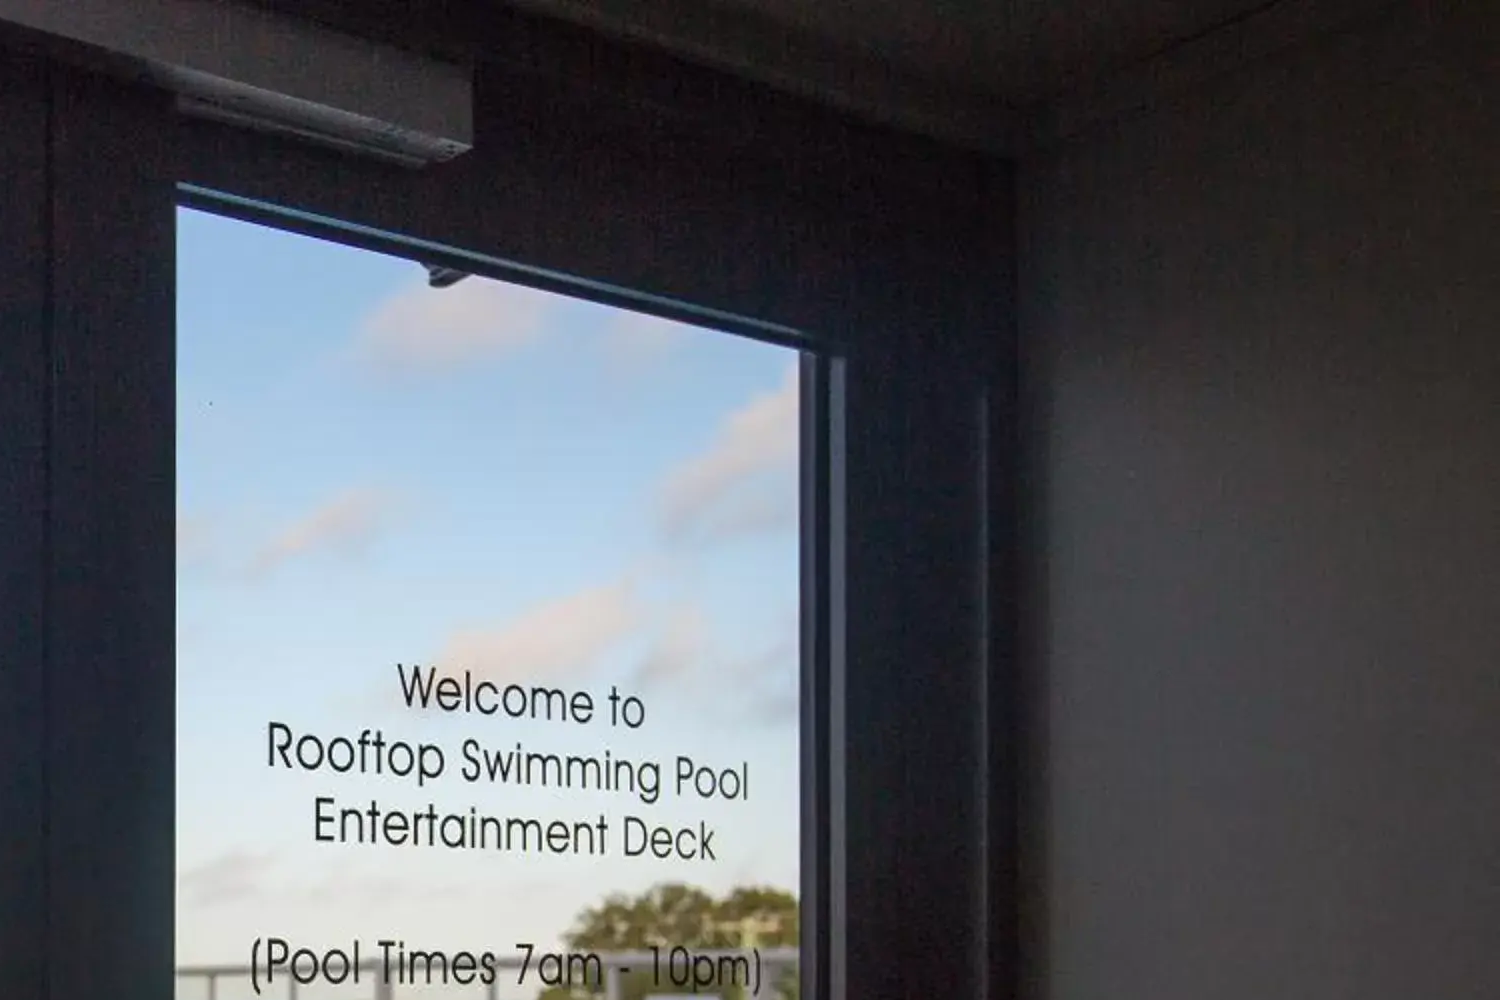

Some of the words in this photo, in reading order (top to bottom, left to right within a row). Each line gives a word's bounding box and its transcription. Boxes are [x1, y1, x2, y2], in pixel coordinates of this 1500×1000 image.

[397, 664, 593, 723] Welcome
[609, 686, 645, 728] to
[267, 722, 445, 786] Rooftop
[461, 739, 660, 803] Swimming
[676, 756, 748, 801] Pool
[315, 797, 608, 855] Entertainment
[624, 816, 716, 860] Deck
[251, 938, 359, 994] (Pool
[378, 940, 496, 985] Times
[515, 943, 602, 986] 7am
[650, 946, 761, 995] 10pm)
